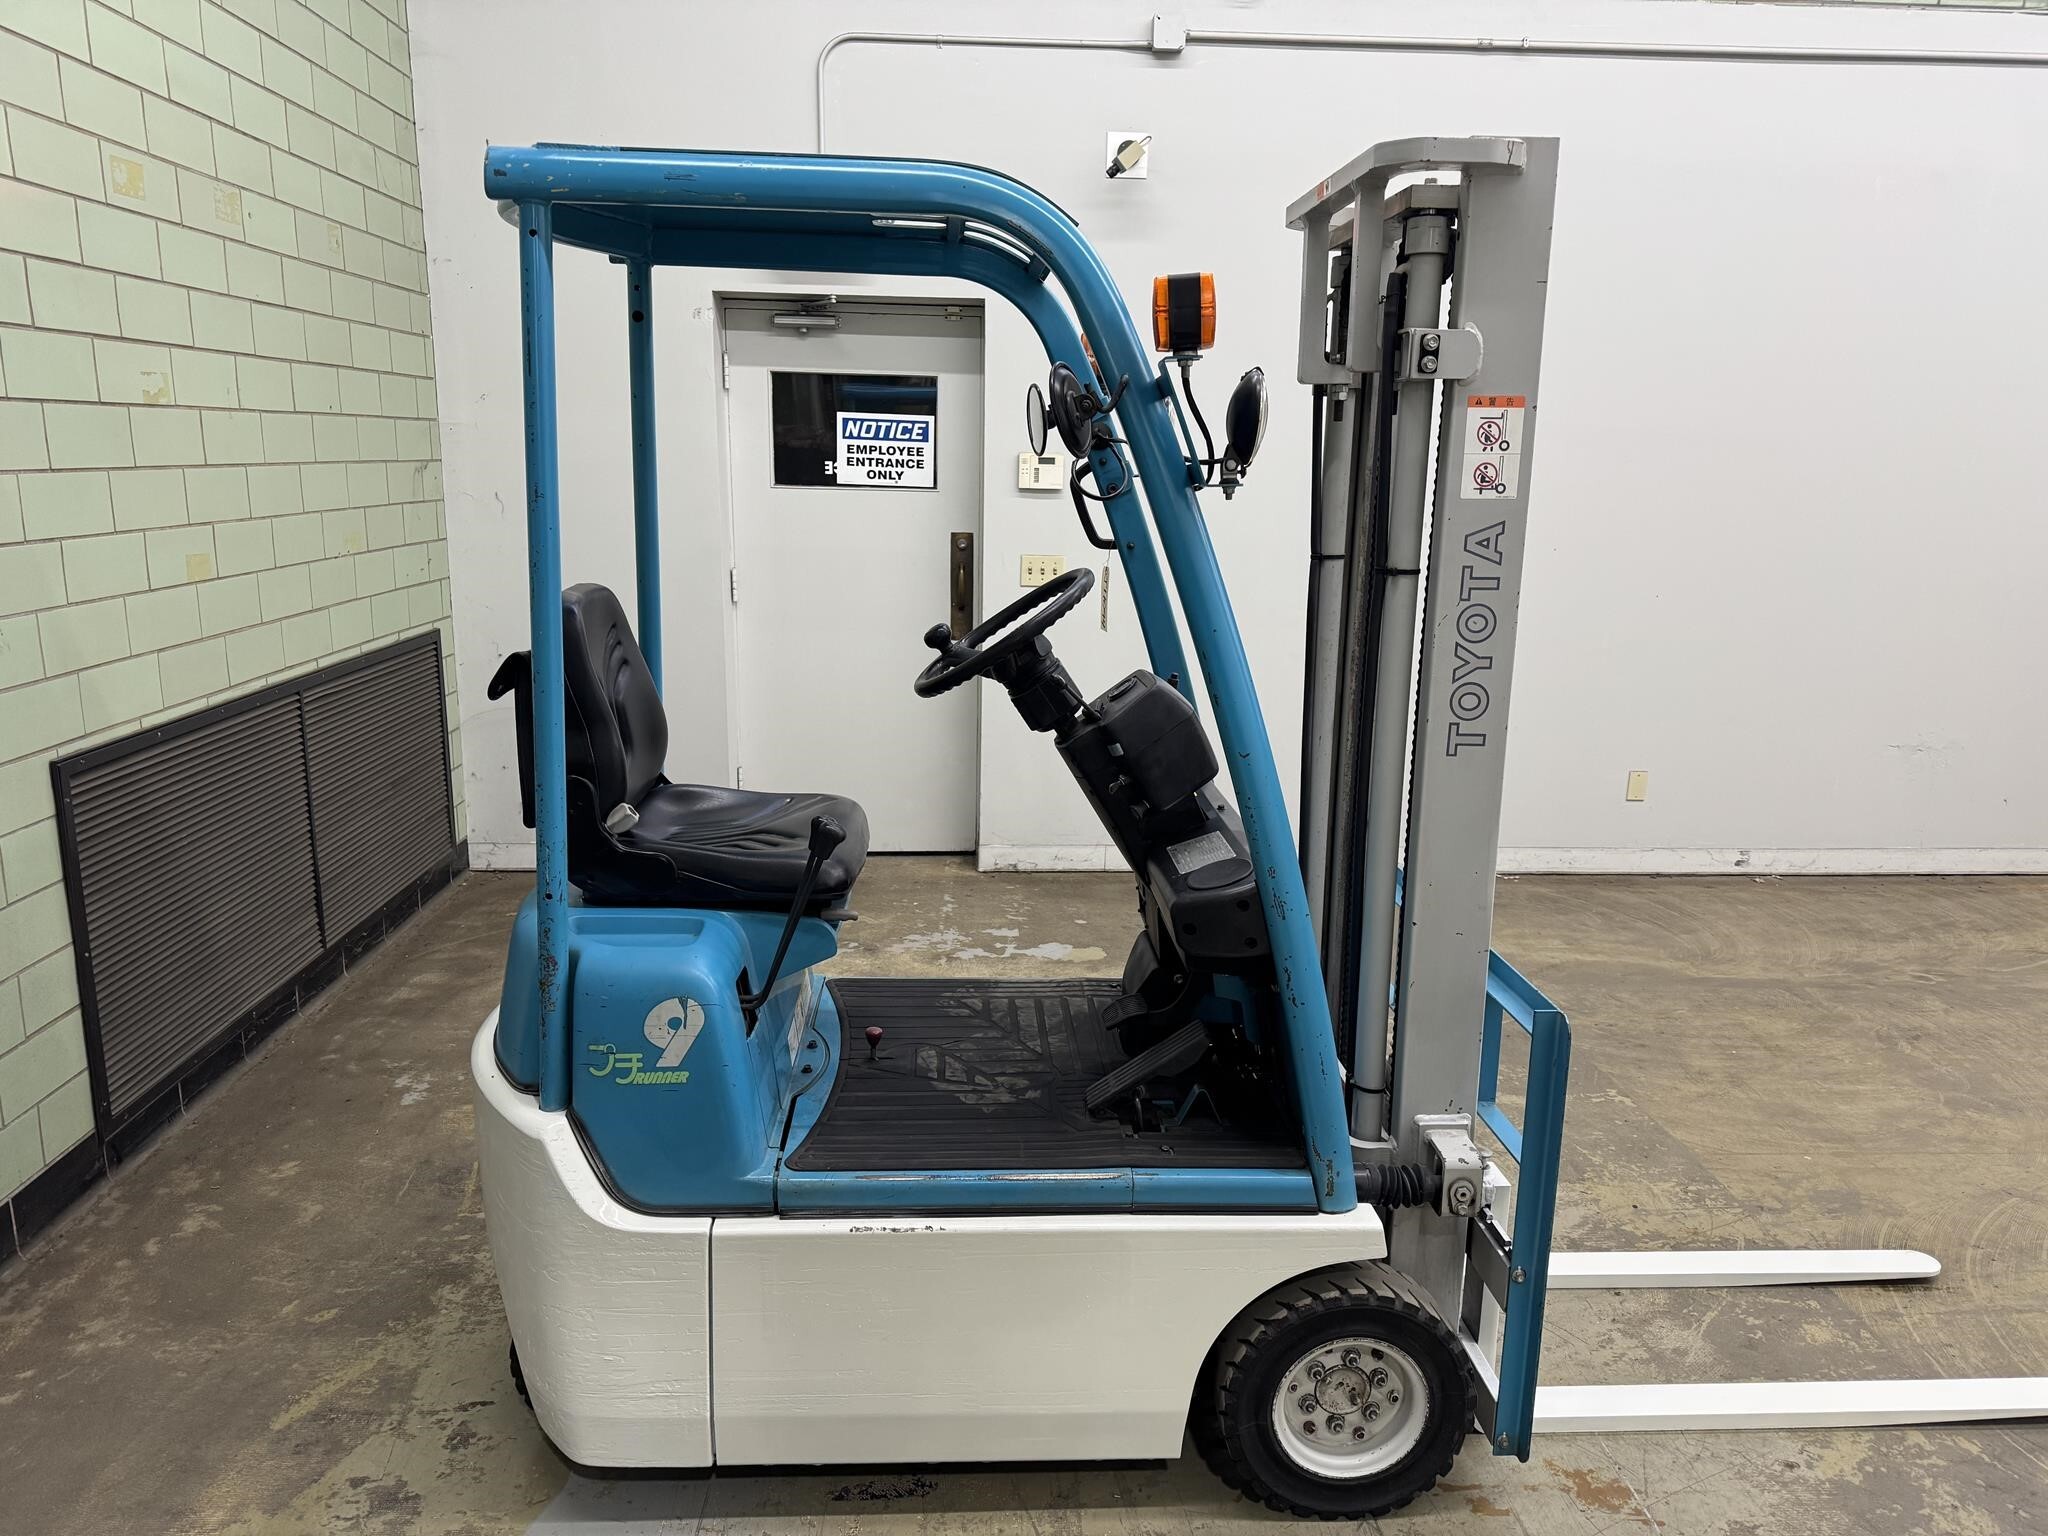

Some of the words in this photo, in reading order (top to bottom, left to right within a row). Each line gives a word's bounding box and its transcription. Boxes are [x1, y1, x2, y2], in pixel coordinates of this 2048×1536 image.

[844, 420, 926, 440] NOTICE
[846, 444, 925, 457] EMPLOYEE
[846, 457, 925, 469] ENTRANCE
[866, 470, 904, 480] ONLY
[1446, 520, 1506, 757] TOYOTA
[643, 997, 705, 1068] 9
[632, 1071, 690, 1085] RUNNER
